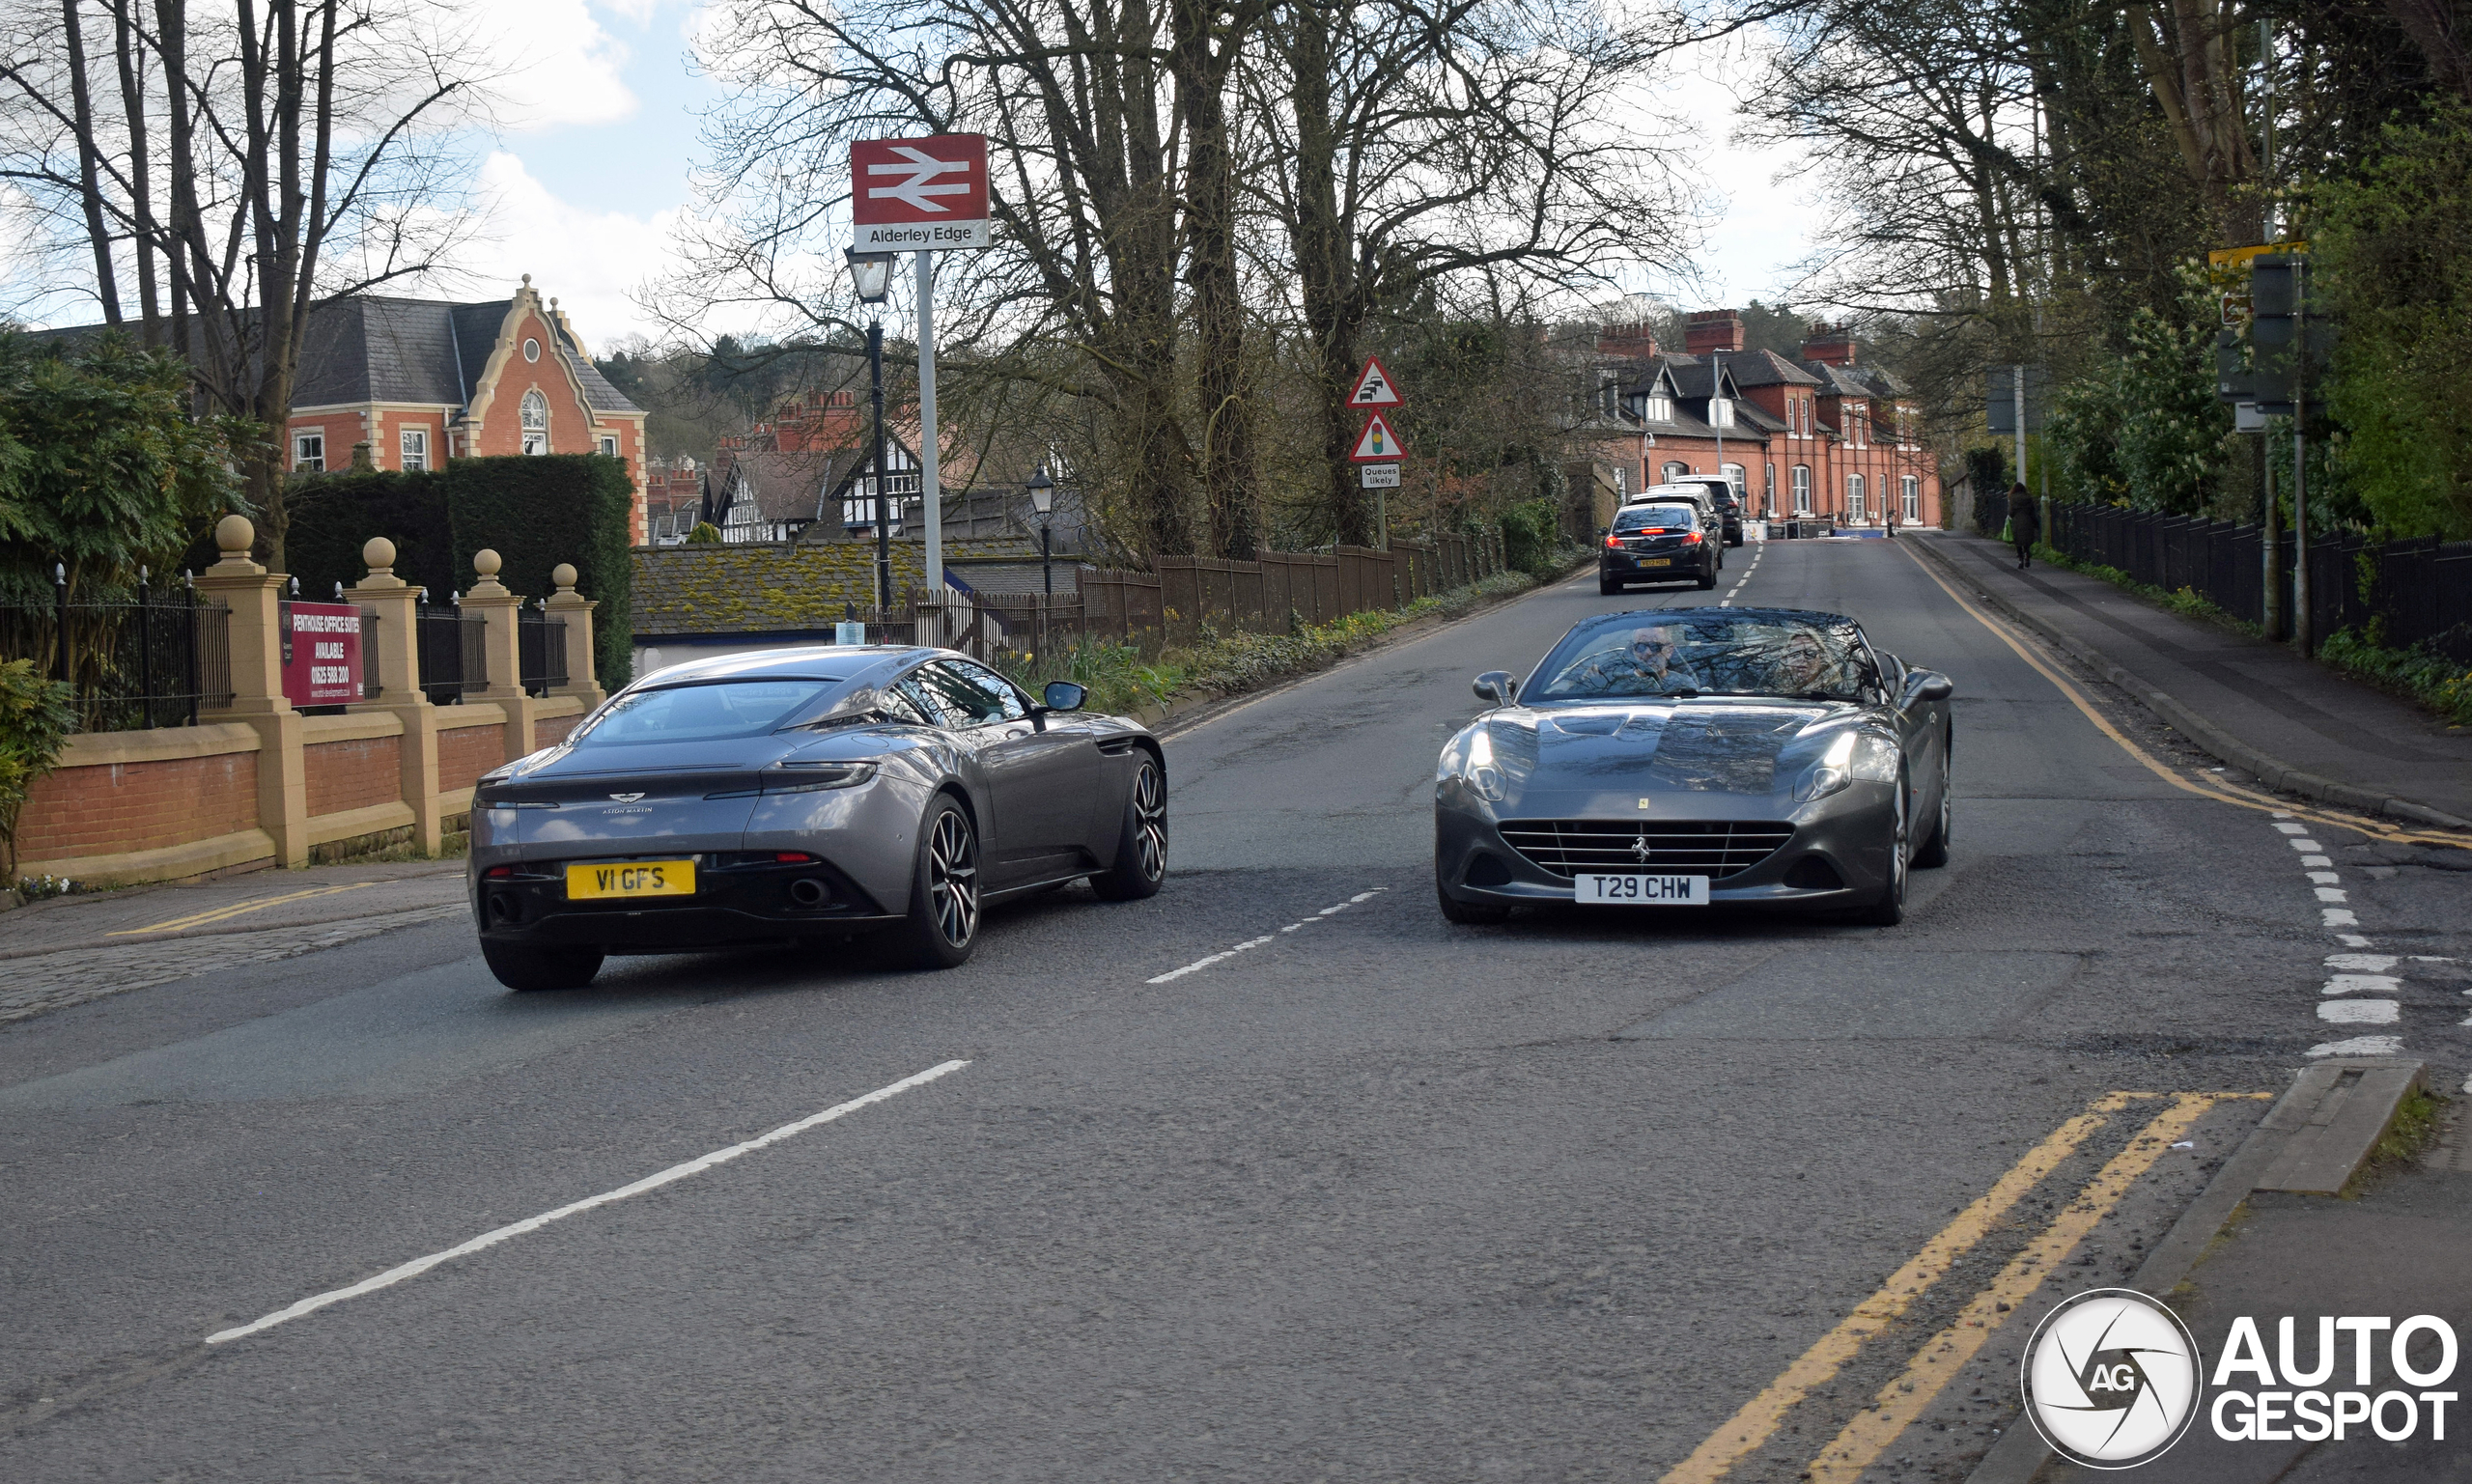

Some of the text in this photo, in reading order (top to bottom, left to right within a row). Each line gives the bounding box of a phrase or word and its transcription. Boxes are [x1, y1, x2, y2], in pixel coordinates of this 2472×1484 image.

[870, 227, 972, 243] Alderley Edge
[294, 614, 359, 633] PENTHOUSE OFFICE SUITES
[315, 642, 344, 658] AVAILABLE
[311, 665, 326, 684] 01625
[338, 665, 349, 684] 200
[622, 867, 664, 890] GFS
[1593, 876, 1691, 899] T29 CHW
